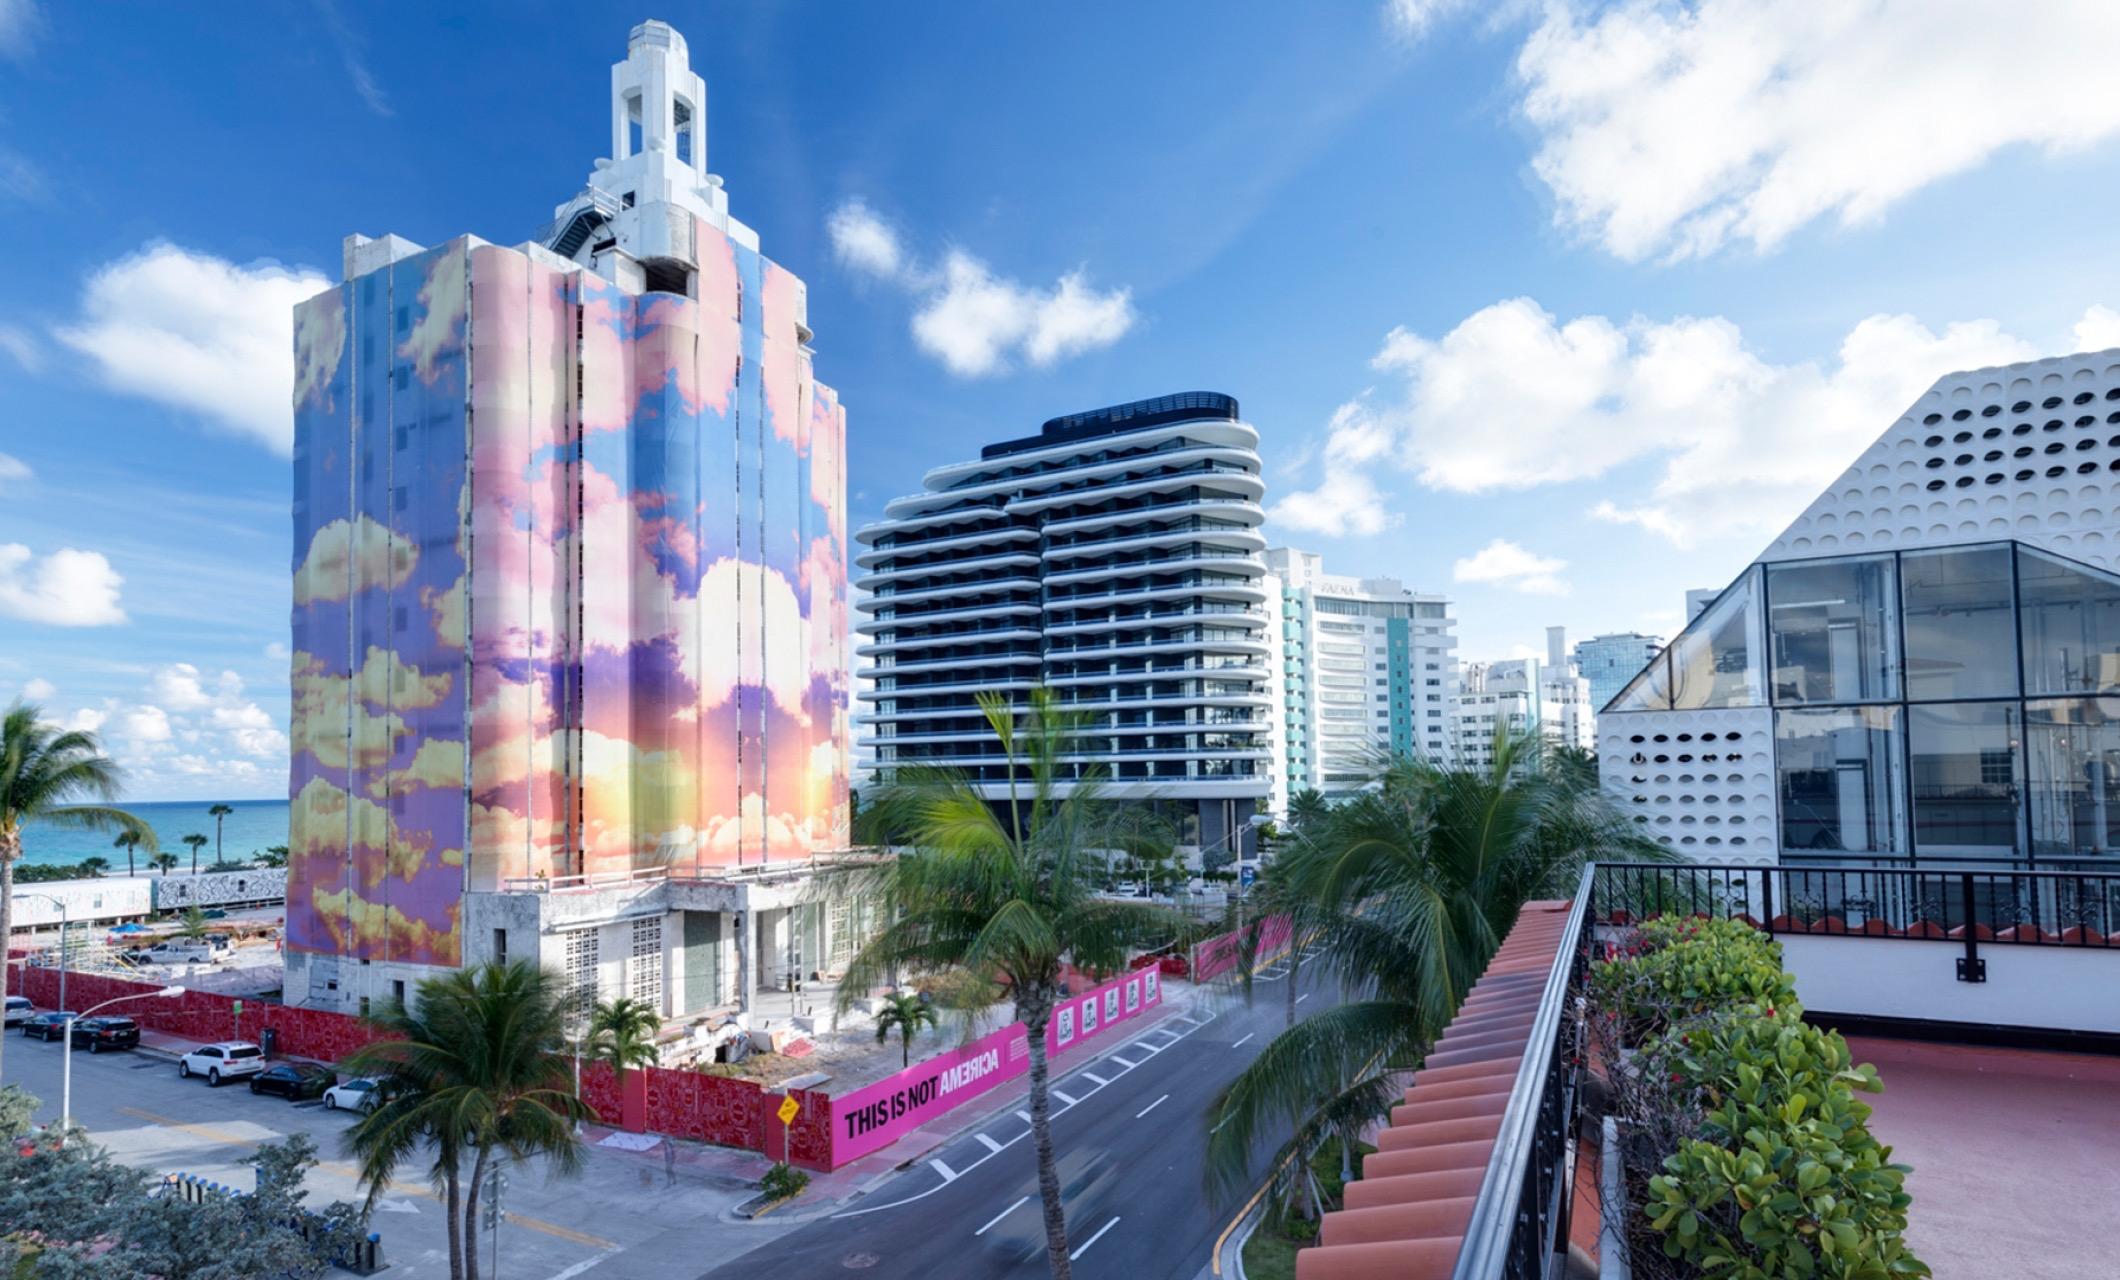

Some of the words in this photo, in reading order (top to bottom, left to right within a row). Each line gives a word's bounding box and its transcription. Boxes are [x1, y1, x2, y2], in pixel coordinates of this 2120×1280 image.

[845, 1099, 889, 1139] THIS
[891, 1091, 906, 1120] IS
[908, 1076, 938, 1111] NOT
